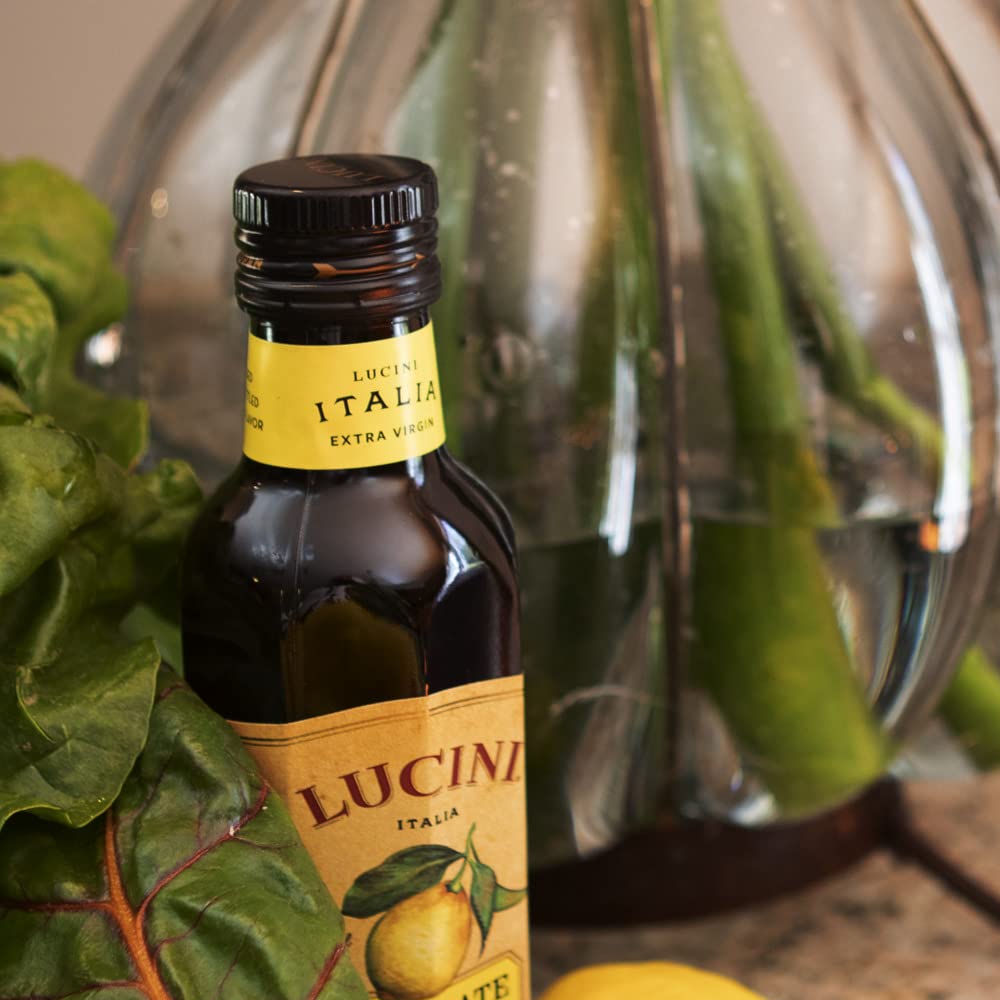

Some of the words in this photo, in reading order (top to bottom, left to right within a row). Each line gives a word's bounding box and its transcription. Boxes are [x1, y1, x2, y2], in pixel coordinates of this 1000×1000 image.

[352, 360, 417, 382] LUCINI
[314, 380, 437, 423] ITALIA
[330, 430, 387, 447] EXTRA
[393, 417, 435, 439] VIRGIN
[296, 740, 524, 830] LUCINI
[397, 807, 460, 831] ITALIA
